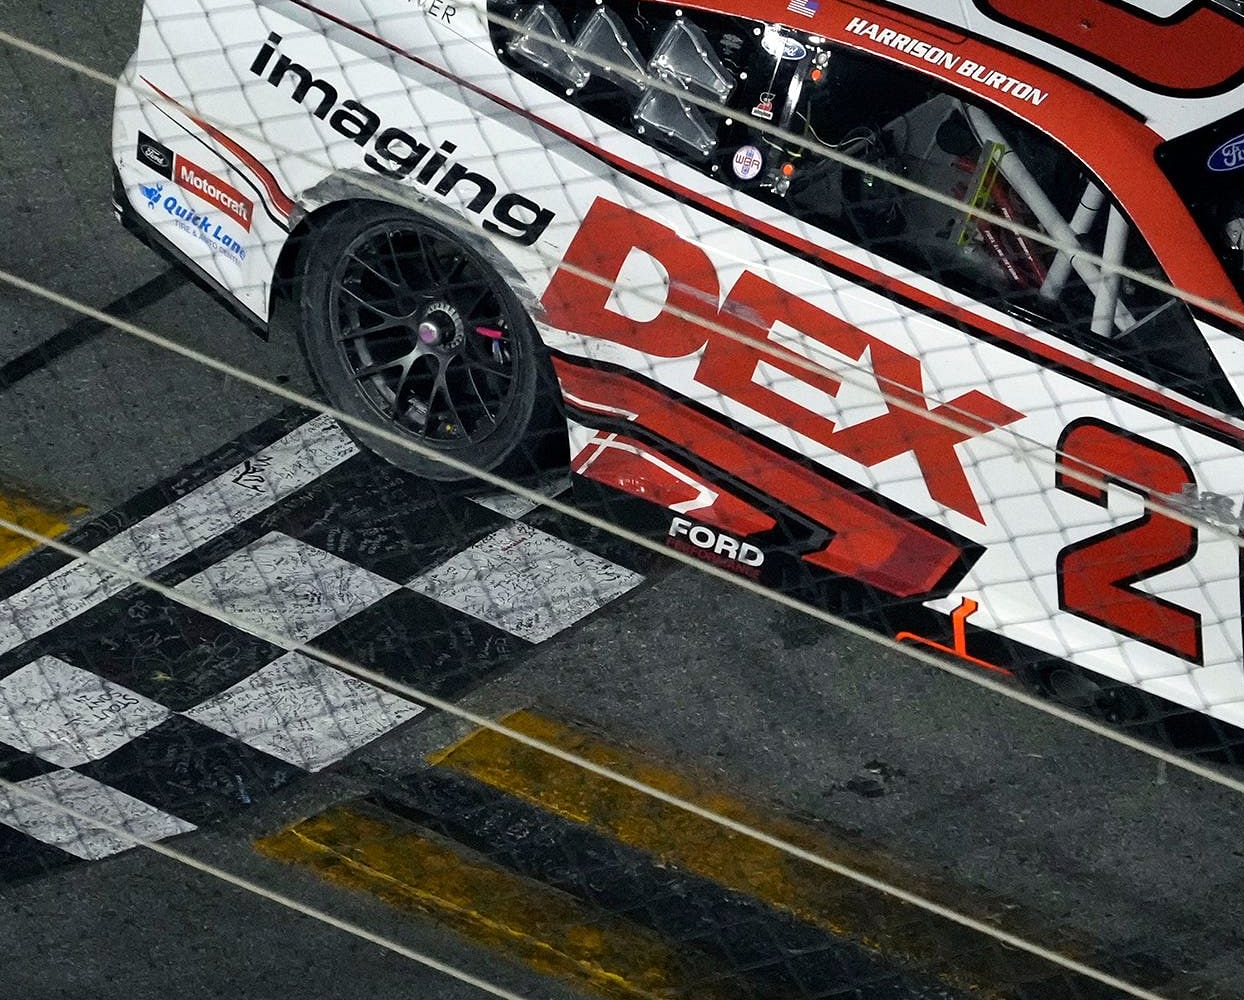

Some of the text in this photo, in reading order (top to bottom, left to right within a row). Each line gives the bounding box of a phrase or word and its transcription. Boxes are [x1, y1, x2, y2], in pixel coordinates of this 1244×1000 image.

[845, 17, 1048, 107] HARRISON BURTON
[145, 146, 165, 165] Ford
[249, 32, 557, 247] imaging
[180, 165, 248, 221] Motorcraft
[163, 196, 246, 261] Quick Lane
[539, 195, 1028, 527] DEX
[668, 516, 765, 567] FORD
